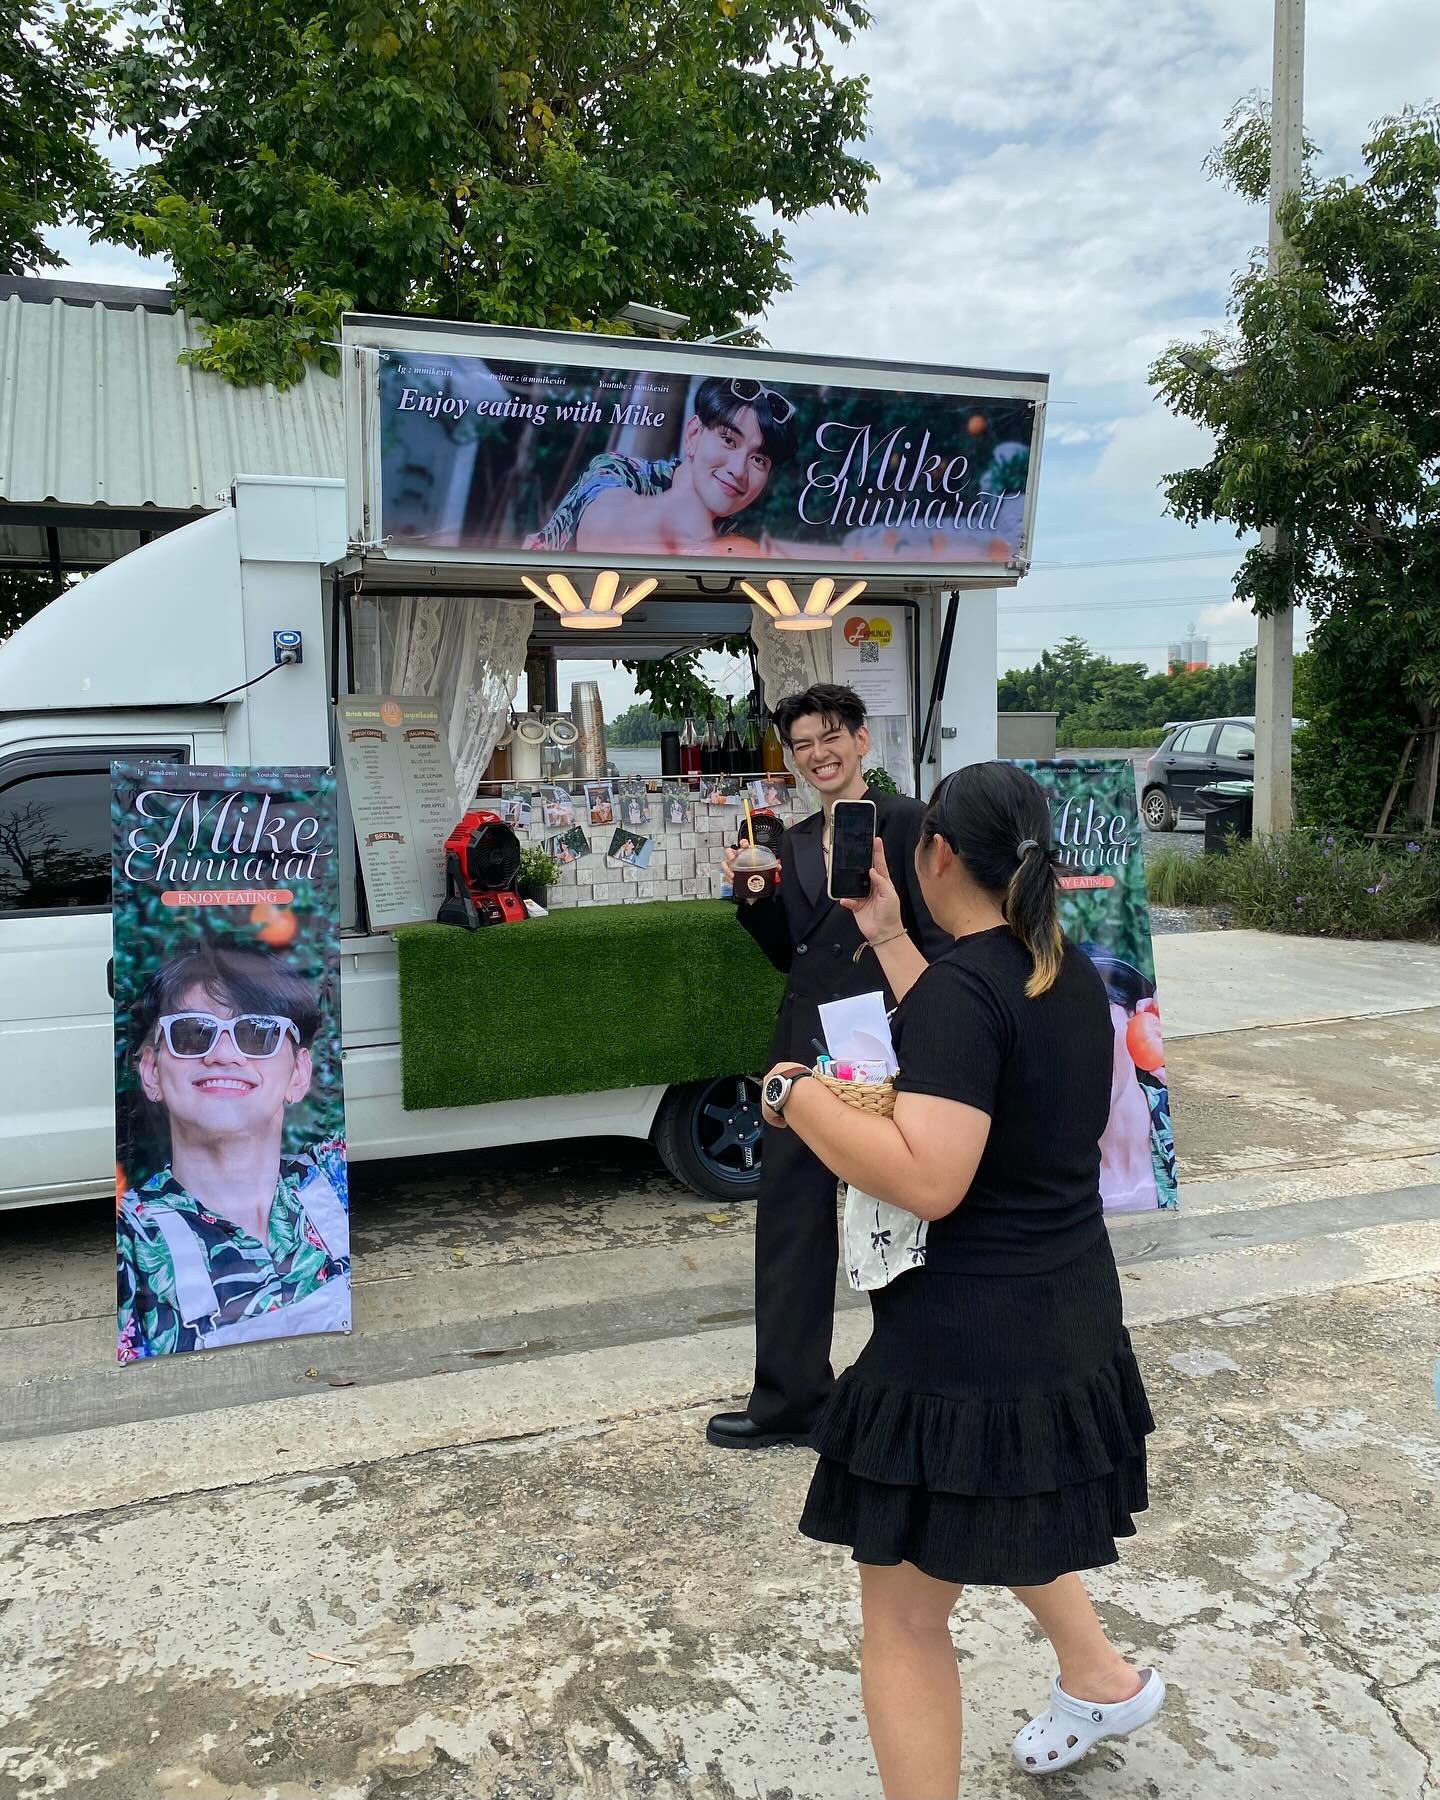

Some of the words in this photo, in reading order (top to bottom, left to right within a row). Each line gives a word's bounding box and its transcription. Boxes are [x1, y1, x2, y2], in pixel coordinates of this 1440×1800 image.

[397, 364, 407, 374] Ig
[413, 366, 454, 377] mmikesiri
[521, 375, 567, 386] @mmikesiri
[599, 380, 628, 390] Youtube
[633, 383, 670, 393] mmikesiri
[397, 388, 470, 420] Enjoy
[476, 396, 549, 426] eating
[555, 401, 602, 423] with
[608, 403, 666, 427] Mike
[806, 422, 970, 493] Mike
[798, 474, 1021, 530] Chinnarat
[128, 790, 324, 855] Mike
[374, 832, 394, 840] BREW
[124, 843, 334, 882] Chinnarat
[1073, 877, 1105, 887] EATING
[178, 892, 222, 904] ENJOY
[227, 891, 277, 903] EATING
